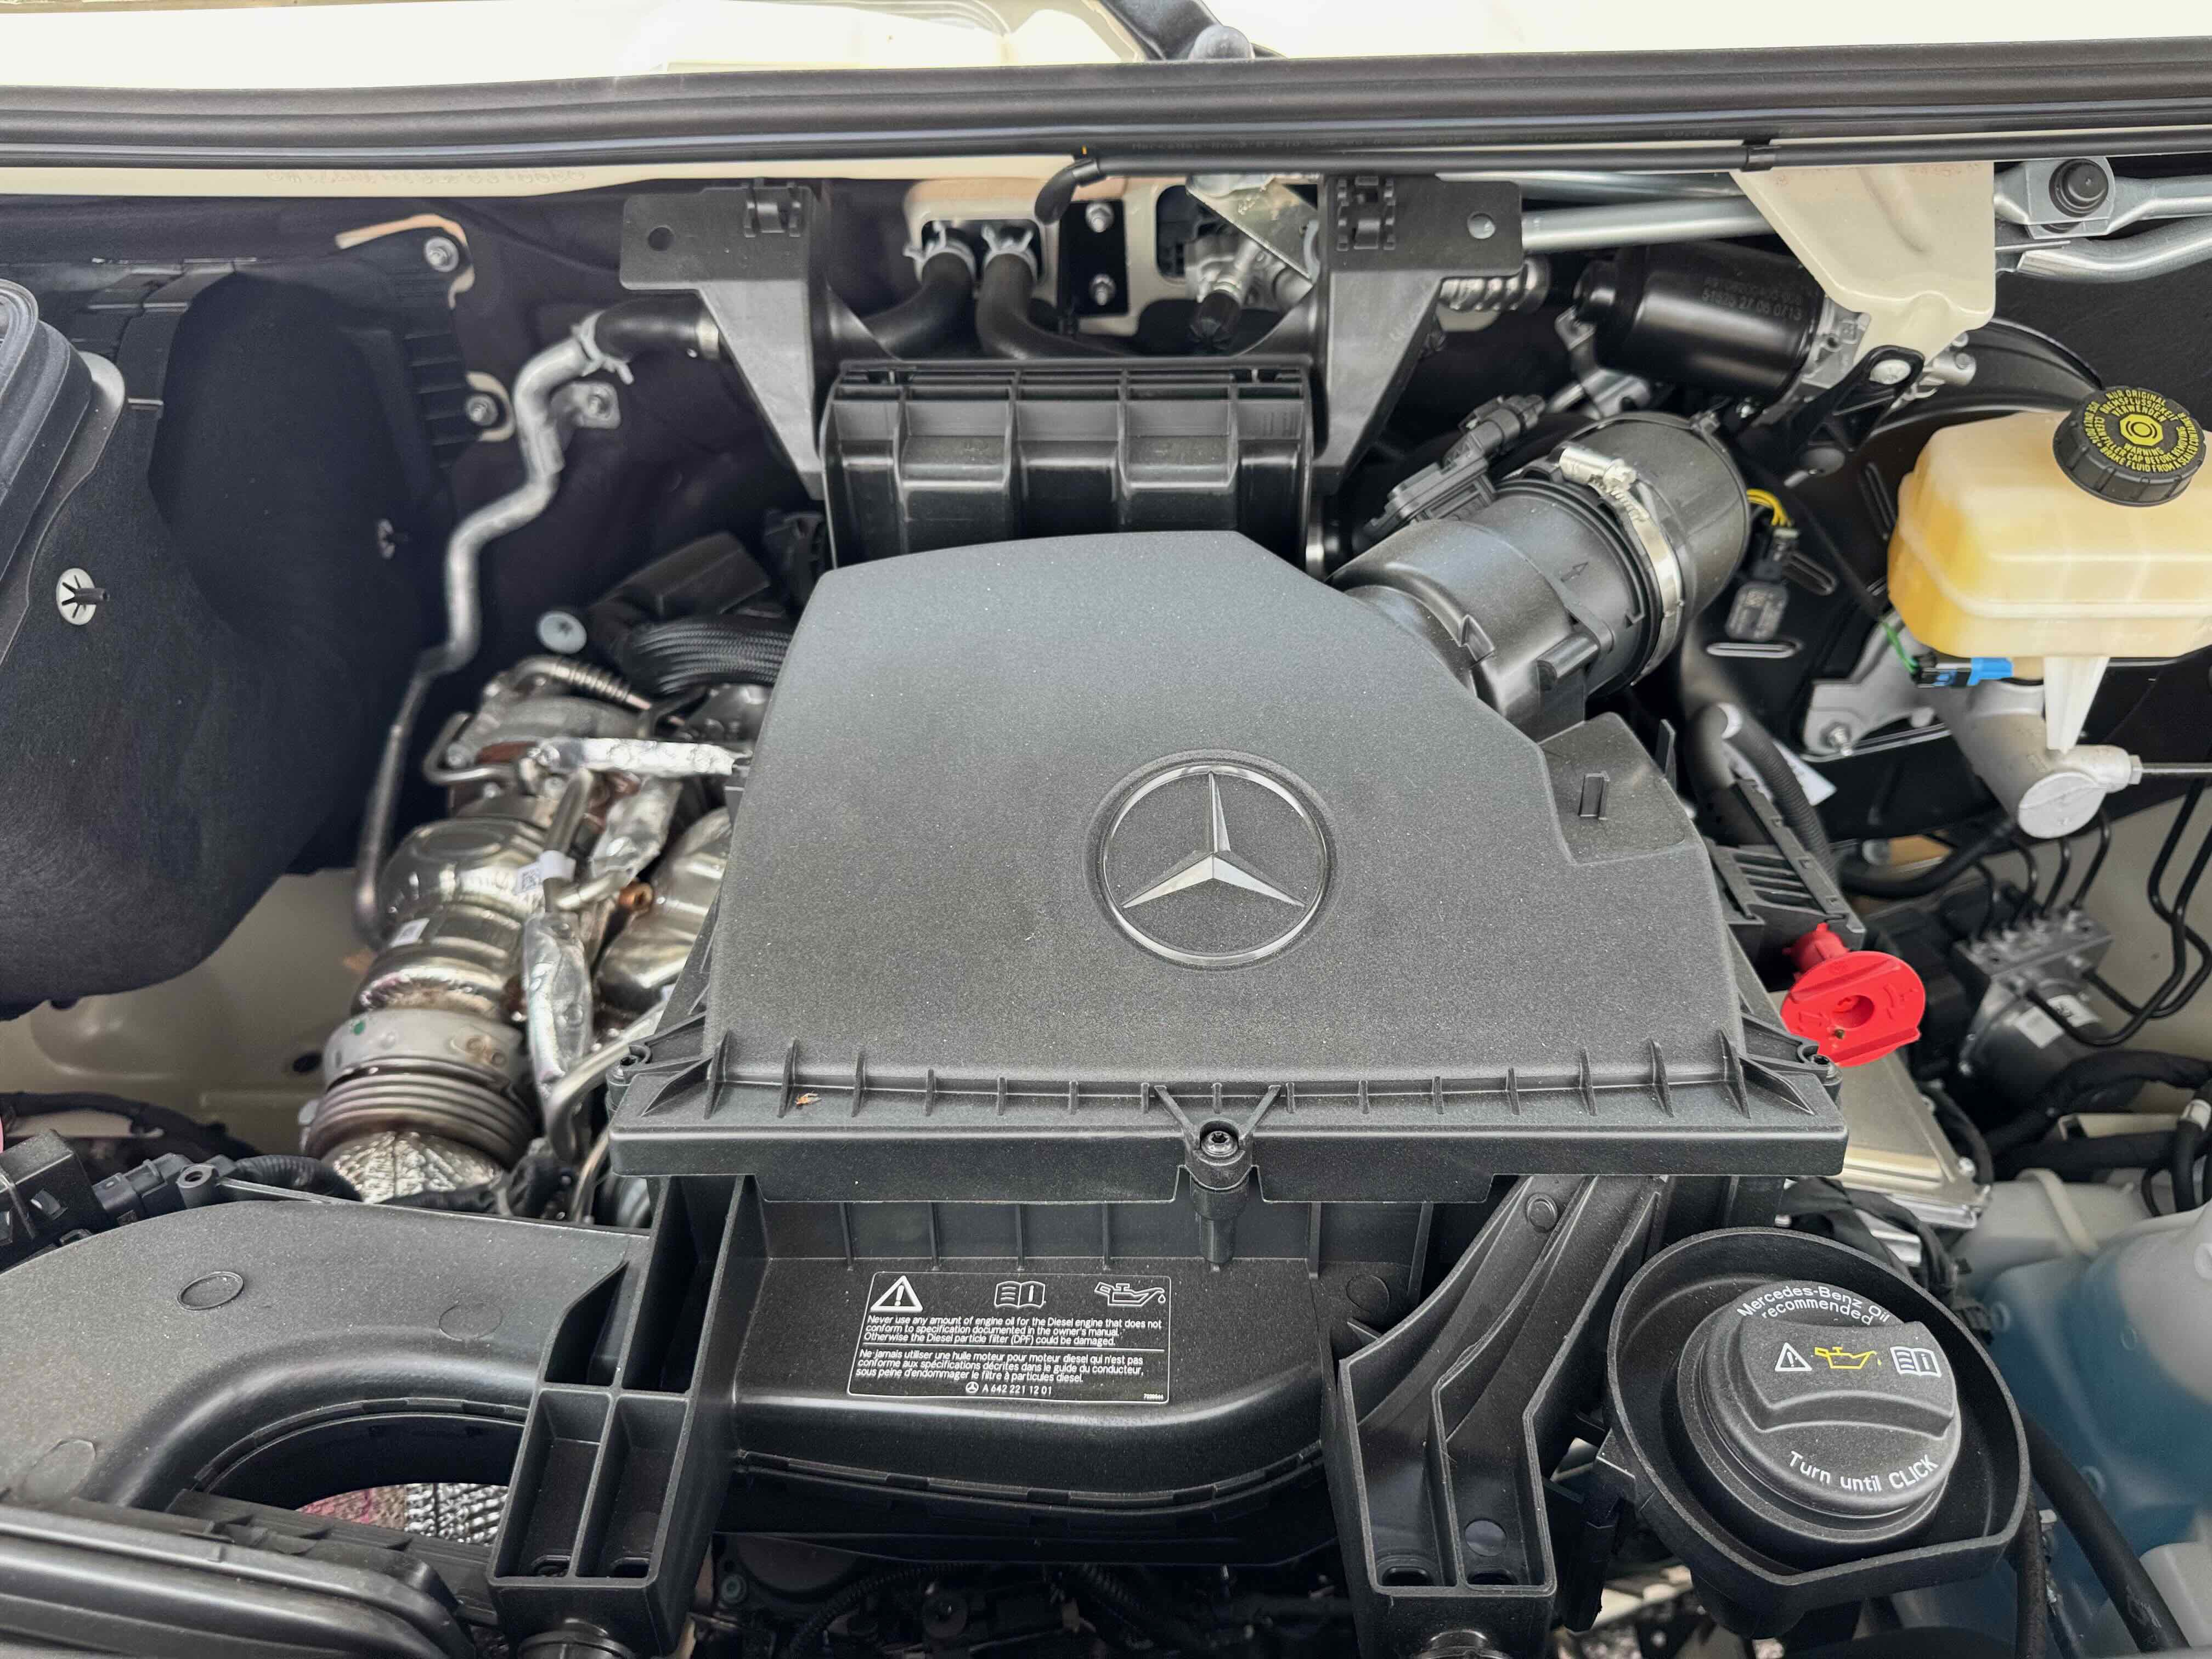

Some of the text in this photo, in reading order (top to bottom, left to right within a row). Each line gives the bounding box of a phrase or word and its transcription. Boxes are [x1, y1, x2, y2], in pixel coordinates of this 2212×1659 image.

[2106, 390, 2166, 407] NUR ORIGINAL
[2111, 405, 2167, 422] VERWENDEN
[2177, 413, 2199, 446] CONTAINER
[2095, 416, 2188, 465] CLEAN FILLER CAP BEFORE REMOVING
[2124, 443, 2164, 455] WARNING
[2100, 447, 2126, 465] BRAKE
[2177, 445, 2198, 466] SEALED
[2126, 460, 2151, 472] FLUID
[2152, 462, 2176, 472] FROM
[2174, 460, 2182, 469] A
[1736, 1285, 1893, 1324] Mercedes-Benz Oil
[1761, 1297, 1874, 1325] recommended
[865, 1323, 902, 1332] conform
[916, 1324, 970, 1335] specification
[972, 1326, 1025, 1335] documented
[1028, 1327, 1035, 1335] in
[1037, 1327, 1051, 1336] the
[1053, 1327, 1086, 1336] owner's
[867, 1314, 893, 1323] Never
[912, 1317, 928, 1325] any
[929, 1316, 961, 1324] amount
[975, 1317, 1003, 1327] engine
[1005, 1317, 1015, 1325] oil
[1032, 1318, 1046, 1326] the
[1048, 1318, 1074, 1327] Diesel
[1075, 1319, 1103, 1330] engine
[1105, 1321, 1122, 1329] that
[1125, 1321, 1146, 1329] does
[1148, 1322, 1162, 1330] not
[864, 1331, 1115, 1348] Otherwise the Diesel particle filter (DPF) could be damaged.
[857, 1359, 901, 1368] conforme
[920, 1360, 981, 1371] spécifications
[983, 1362, 1019, 1370] décrites
[1021, 1363, 1042, 1371] dans
[1043, 1363, 1051, 1372] le
[1053, 1364, 1077, 1374] guide
[1092, 1364, 1144, 1375] conducteur,
[874, 1350, 902, 1361] jamais
[904, 1351, 933, 1359] utiliser
[952, 1352, 972, 1360] huile
[973, 1352, 1006, 1361] moteur
[1007, 1355, 1027, 1363] pour
[1029, 1354, 1060, 1362] moteur
[1063, 1355, 1088, 1363] diesel
[1090, 1355, 1103, 1365] qui
[1104, 1356, 1126, 1364] n'est
[1127, 1358, 1143, 1367] pas
[878, 1368, 902, 1379] peine
[904, 1369, 969, 1380] d'endommager
[970, 1370, 979, 1379] le
[981, 1370, 1002, 1379] filtre
[1004, 1371, 1009, 1380] à
[1011, 1372, 1054, 1383] particules
[1056, 1373, 1083, 1381] diesel.
[982, 1384, 1052, 1395] A 642 221 12 01
[1788, 1451, 1939, 1492] Turn until CLICK
